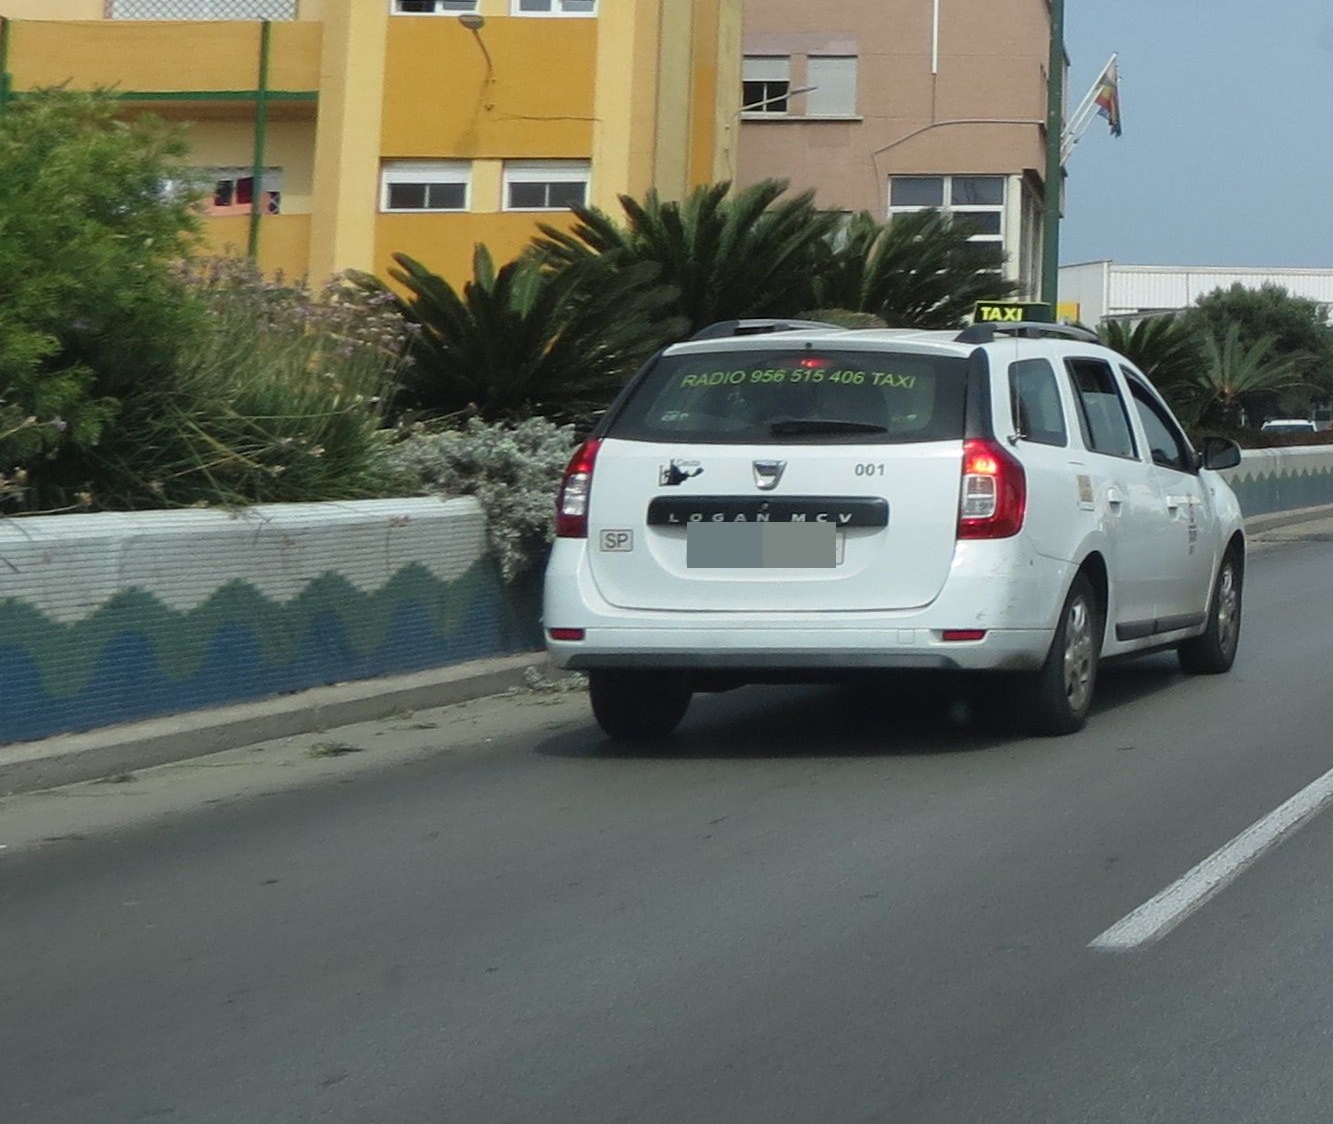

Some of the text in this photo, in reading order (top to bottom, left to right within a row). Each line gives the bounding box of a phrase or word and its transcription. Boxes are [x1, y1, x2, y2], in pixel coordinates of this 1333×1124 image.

[979, 307, 1023, 322] TAXI
[681, 369, 915, 389] RADIO 956 515 406 TAXI
[854, 463, 885, 477] 001
[669, 512, 853, 523] LOGAN MCV
[605, 532, 629, 549] SP
